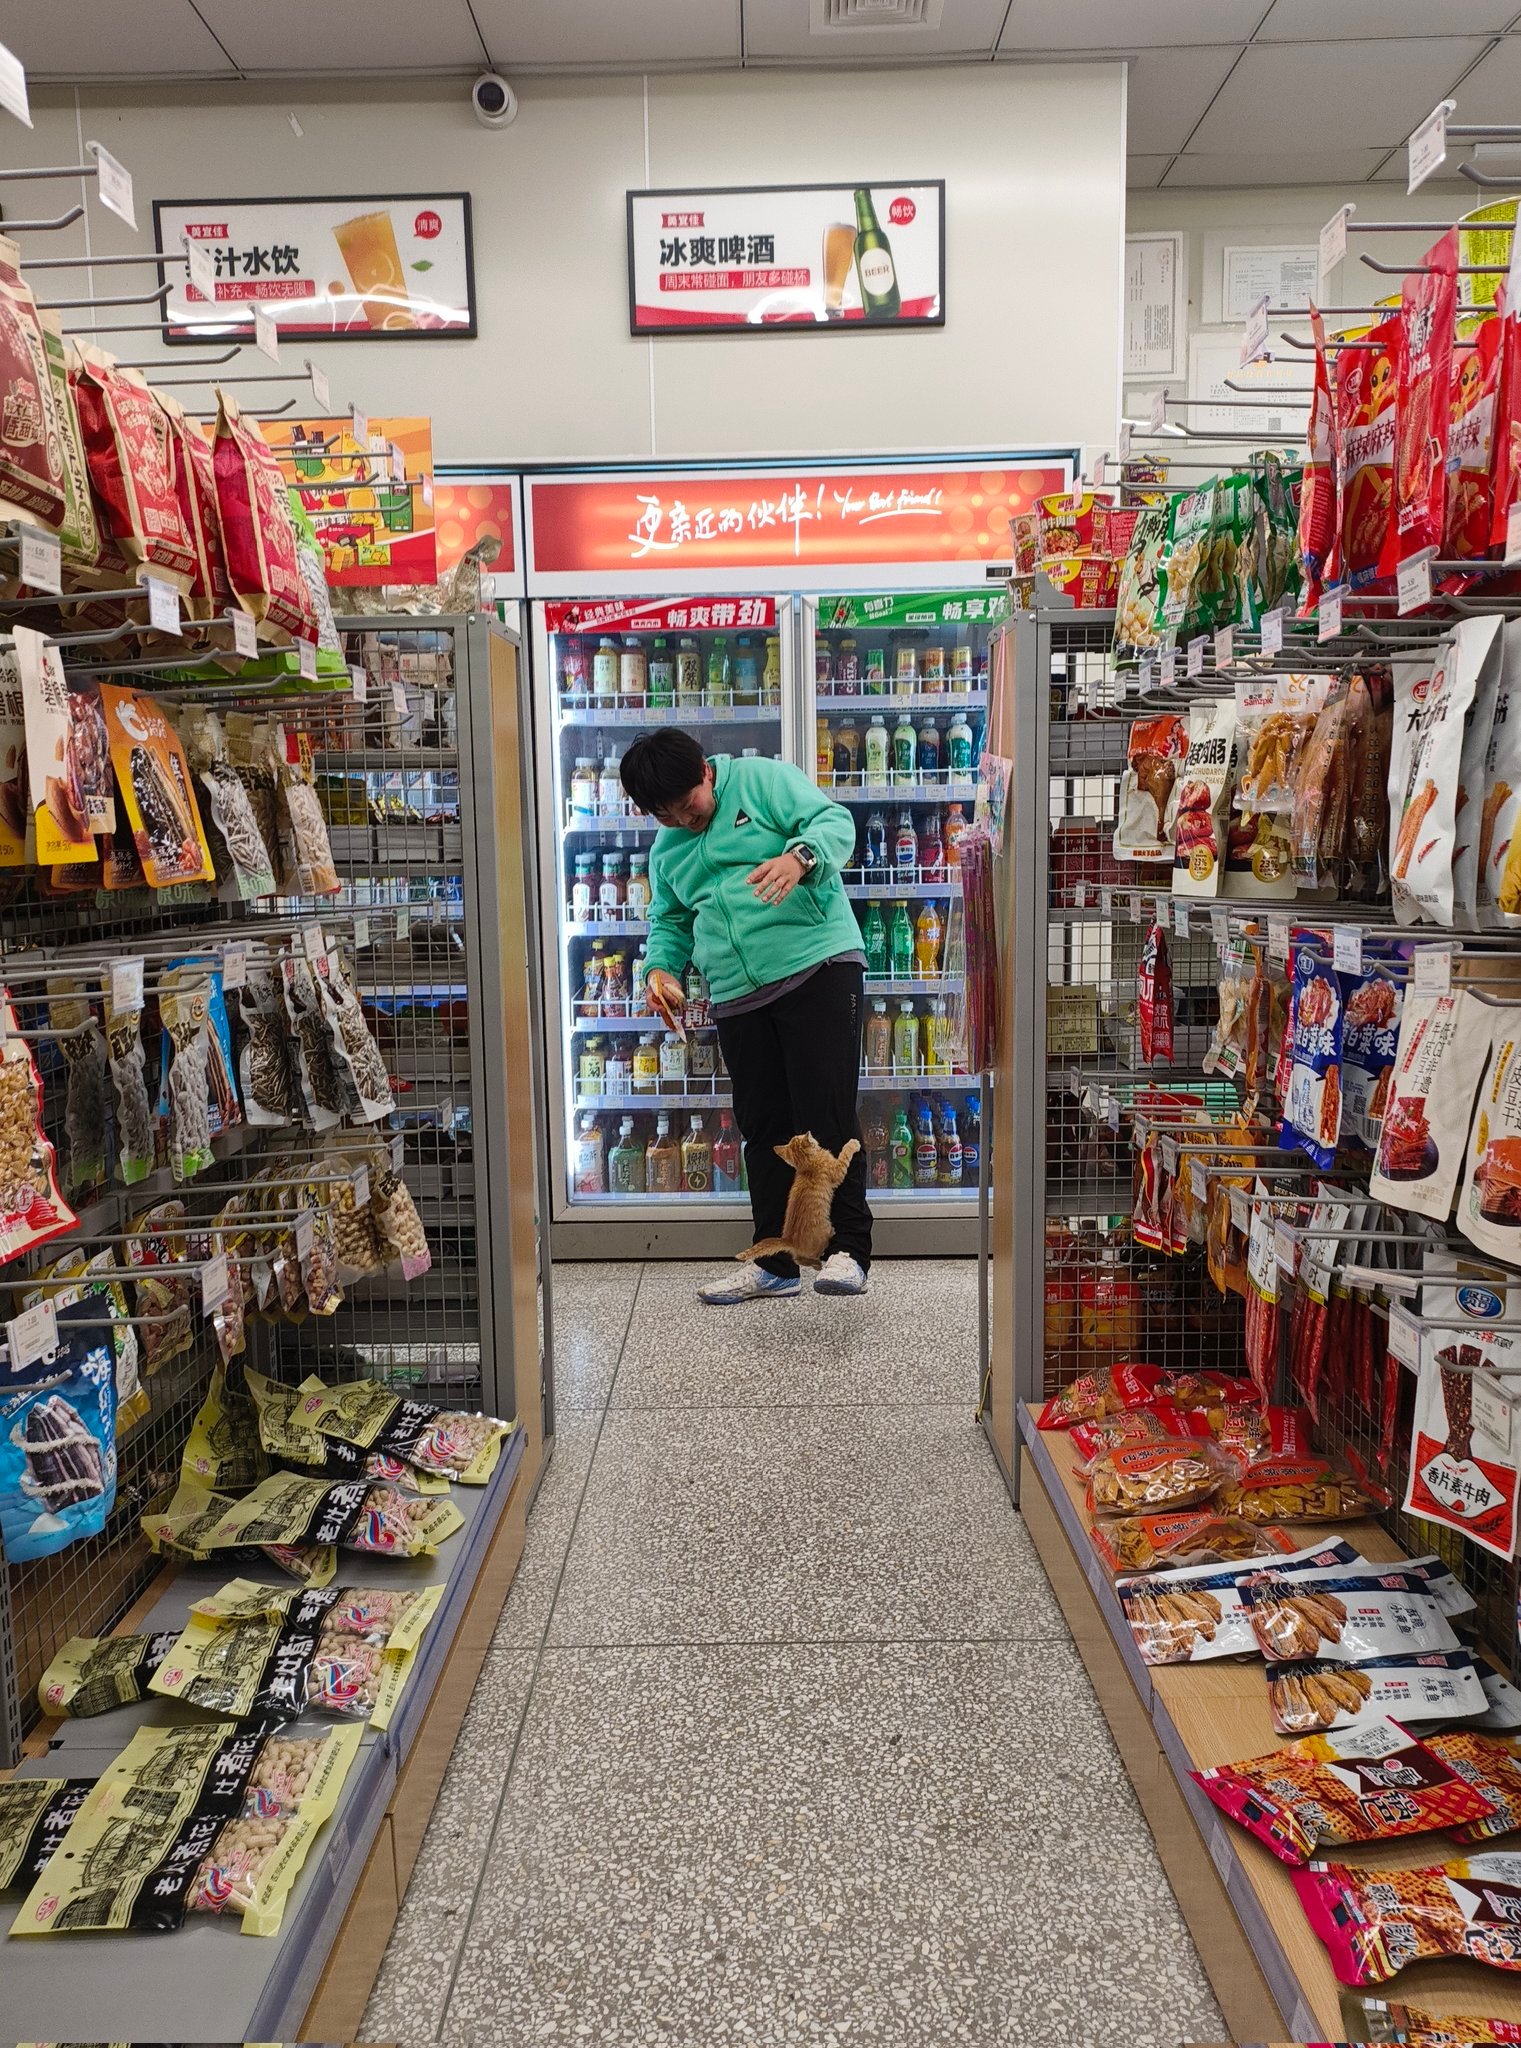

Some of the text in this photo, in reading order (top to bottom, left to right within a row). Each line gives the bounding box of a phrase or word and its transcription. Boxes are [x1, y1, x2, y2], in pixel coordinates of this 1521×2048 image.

[185, 245, 300, 277] 汁水饮
[659, 234, 775, 267] 冰爽啤酒
[864, 265, 890, 278] BEER
[191, 281, 308, 299] 活补充、畅饮无限
[667, 599, 767, 628] 畅爽带劲
[1193, 858, 1208, 867] 23%
[1260, 859, 1278, 868] 23%
[1426, 1466, 1491, 1507] 香片素牛肉
